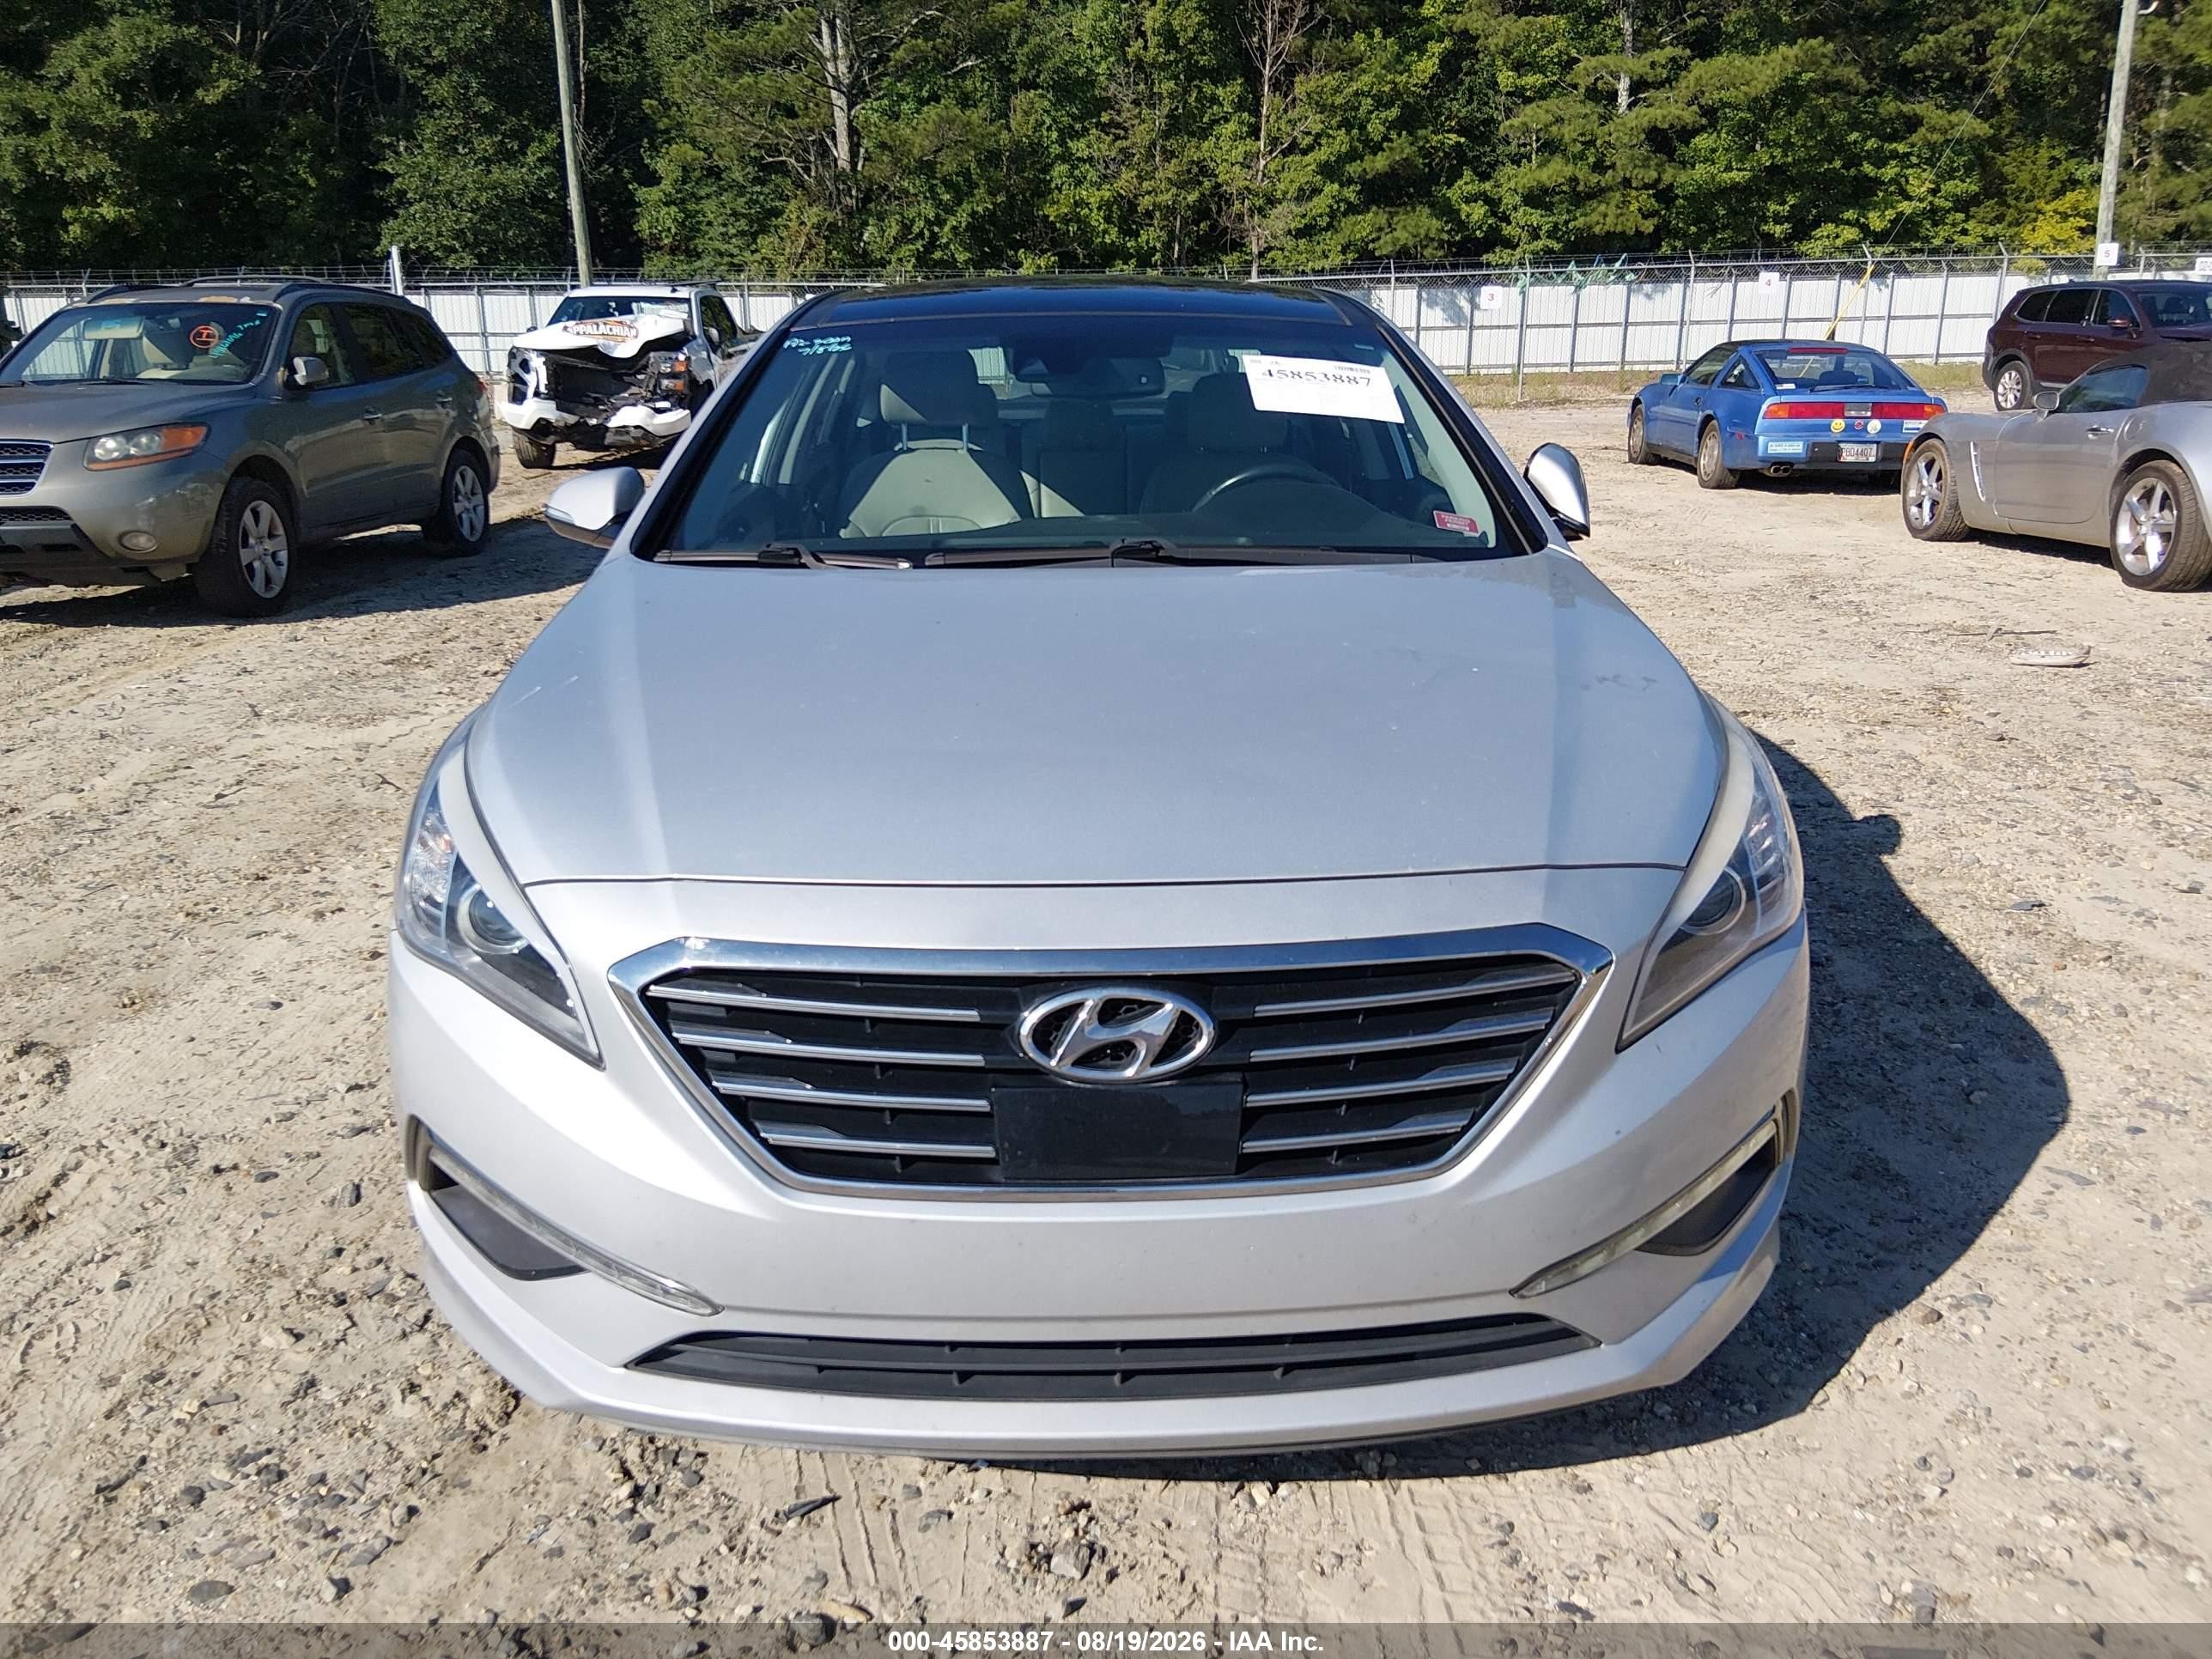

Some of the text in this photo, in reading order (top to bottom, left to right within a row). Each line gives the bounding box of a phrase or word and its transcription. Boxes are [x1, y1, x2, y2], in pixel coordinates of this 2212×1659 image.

[1487, 293, 1495, 301] 3
[567, 322, 638, 338] APPALACHIAN
[1262, 368, 1371, 387] 45853887
